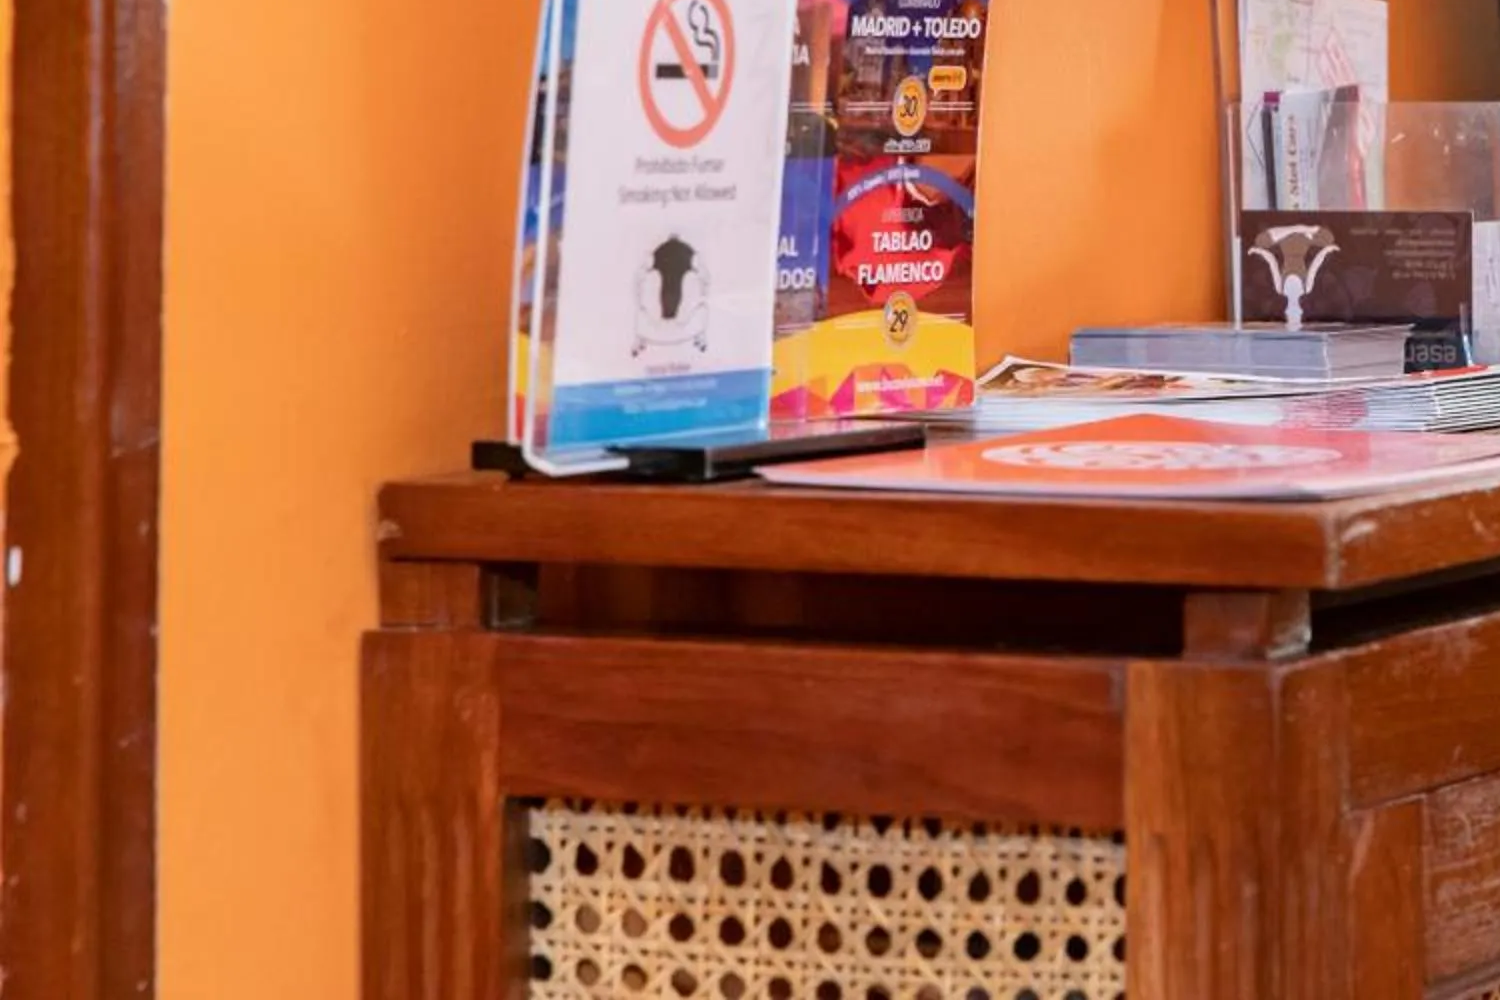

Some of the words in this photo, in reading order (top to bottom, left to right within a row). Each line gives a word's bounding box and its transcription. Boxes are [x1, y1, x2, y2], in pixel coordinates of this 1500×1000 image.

[851, 16, 911, 37] MADRID
[912, 21, 923, 37] +
[923, 16, 982, 38] TOLEDO
[871, 230, 933, 254] TABLAO
[857, 262, 944, 286] FLAMENCO
